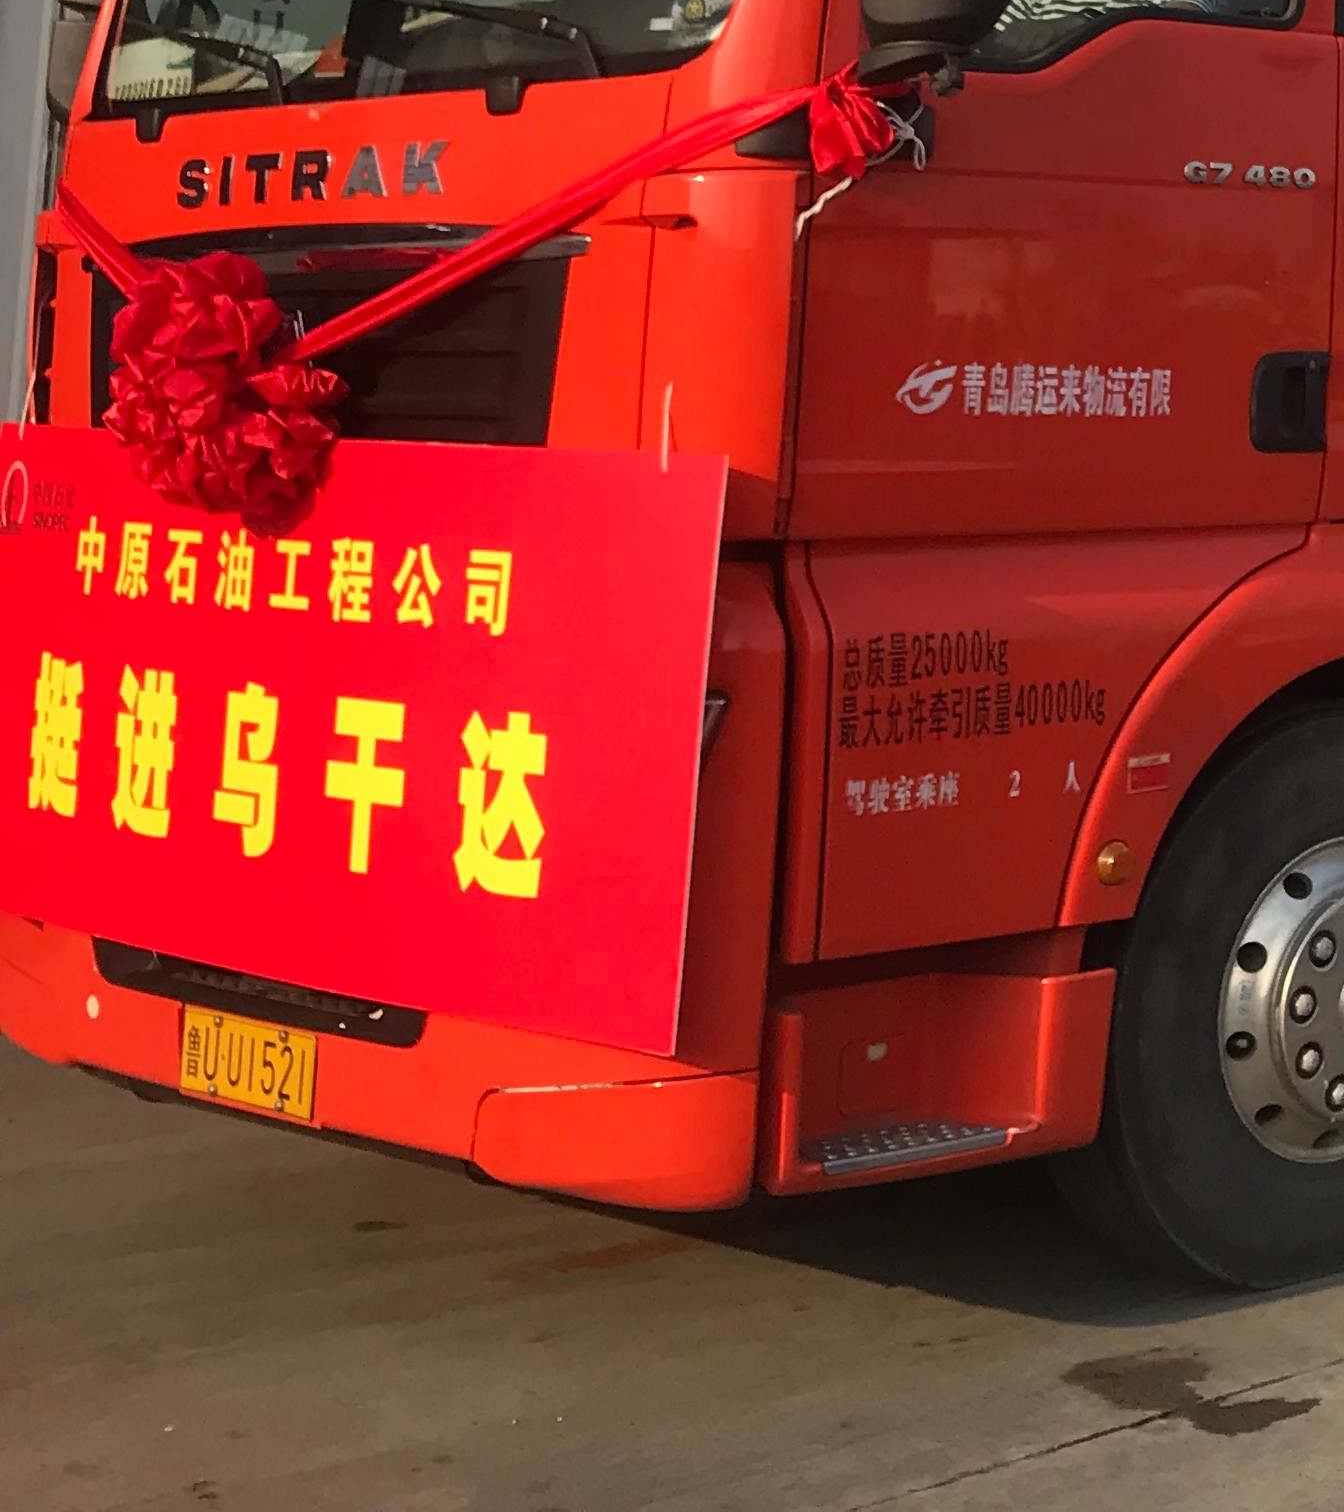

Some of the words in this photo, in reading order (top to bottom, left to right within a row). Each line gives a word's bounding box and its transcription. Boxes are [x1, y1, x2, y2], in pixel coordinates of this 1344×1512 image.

[177, 141, 449, 210] SITRAK
[1184, 160, 1233, 185] G7
[1244, 164, 1319, 189] 480
[76, 515, 513, 636] 中原石油工程公司
[843, 630, 1009, 691] 总质量25000kg
[838, 679, 1106, 748] 最大允许牵引质量40000kg
[29, 651, 547, 899] 挺进乌干达
[1008, 769, 1022, 798] 2
[1062, 759, 1082, 794] 人
